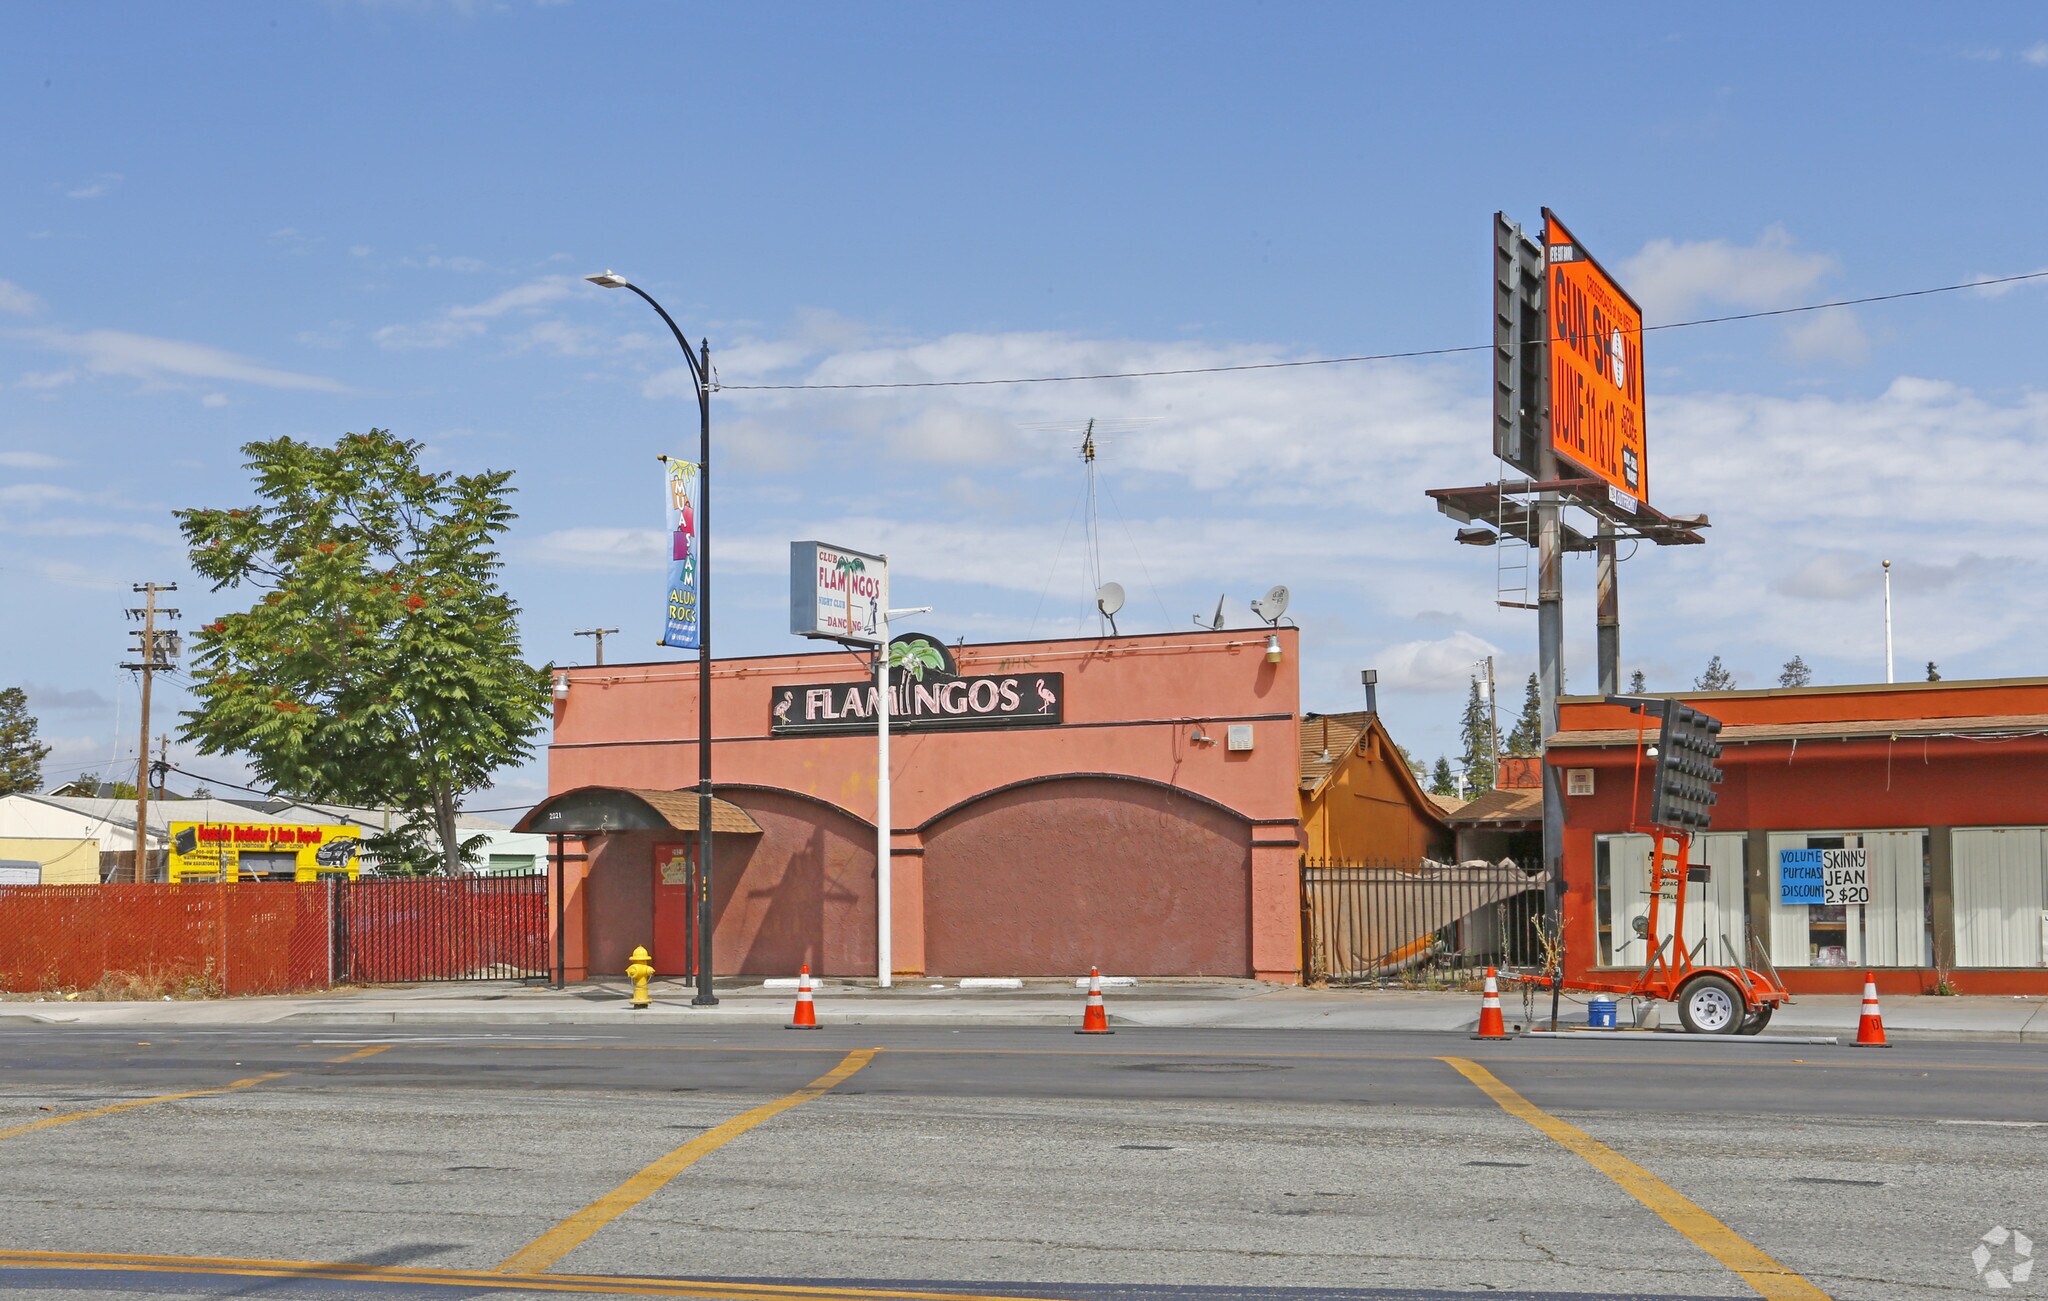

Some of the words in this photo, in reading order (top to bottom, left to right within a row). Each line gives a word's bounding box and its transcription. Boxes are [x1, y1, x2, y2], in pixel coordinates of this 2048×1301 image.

[1555, 266, 1589, 362] GUN
[1593, 304, 1637, 406] SHOW
[1555, 356, 1585, 453] JUNE
[1586, 383, 1597, 463] 11
[1605, 399, 1617, 477] 12
[819, 551, 838, 563] CLUB
[669, 588, 696, 606] ALUM
[669, 605, 696, 623] ROCK
[805, 678, 1021, 720] FLAMINGOS
[233, 825, 268, 843] Radiator
[277, 827, 295, 844] Auto
[297, 827, 322, 847] Repair
[1781, 851, 1822, 863] VOLUME
[1823, 850, 1866, 869] SKINNY
[1783, 867, 1823, 879] PUrCHAS
[1825, 870, 1865, 887] JEAN
[1782, 885, 1824, 898] DISCOUNT
